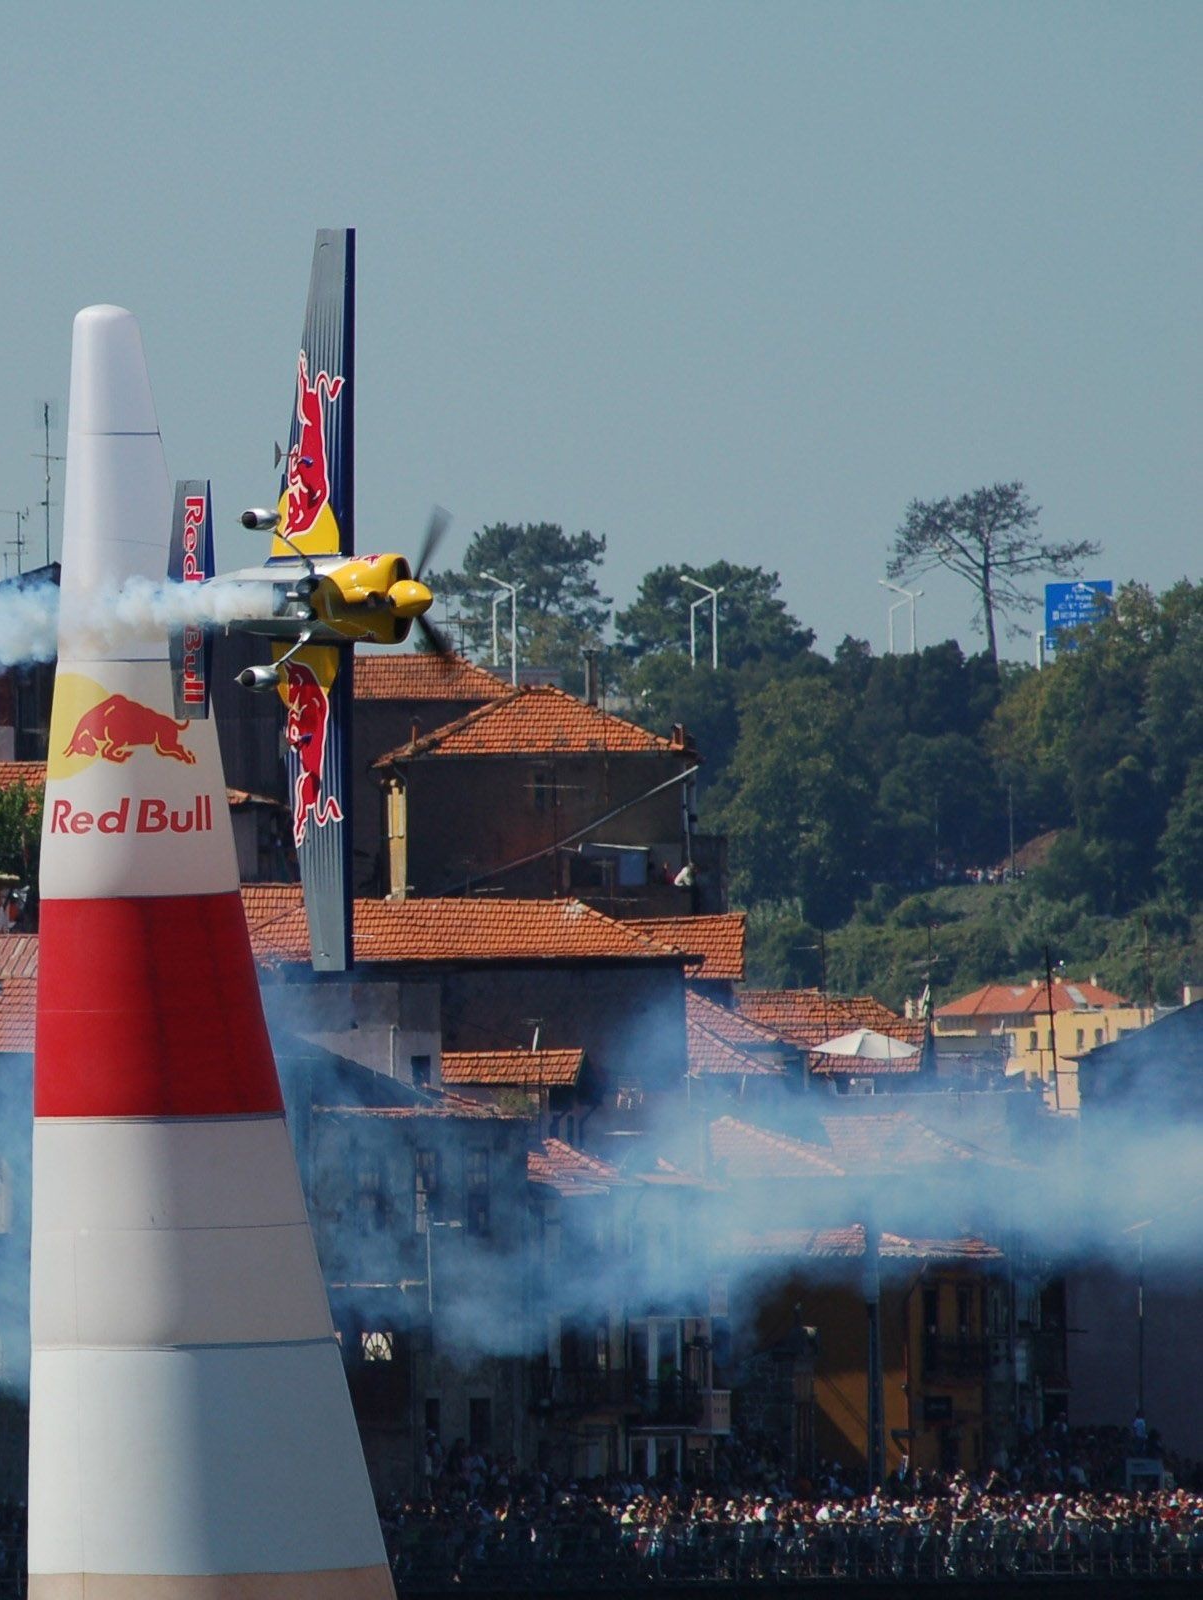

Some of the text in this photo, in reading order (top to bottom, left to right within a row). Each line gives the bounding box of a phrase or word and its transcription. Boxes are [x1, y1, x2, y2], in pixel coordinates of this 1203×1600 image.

[183, 496, 205, 704] Red Bull
[50, 795, 213, 835] Red Bull
